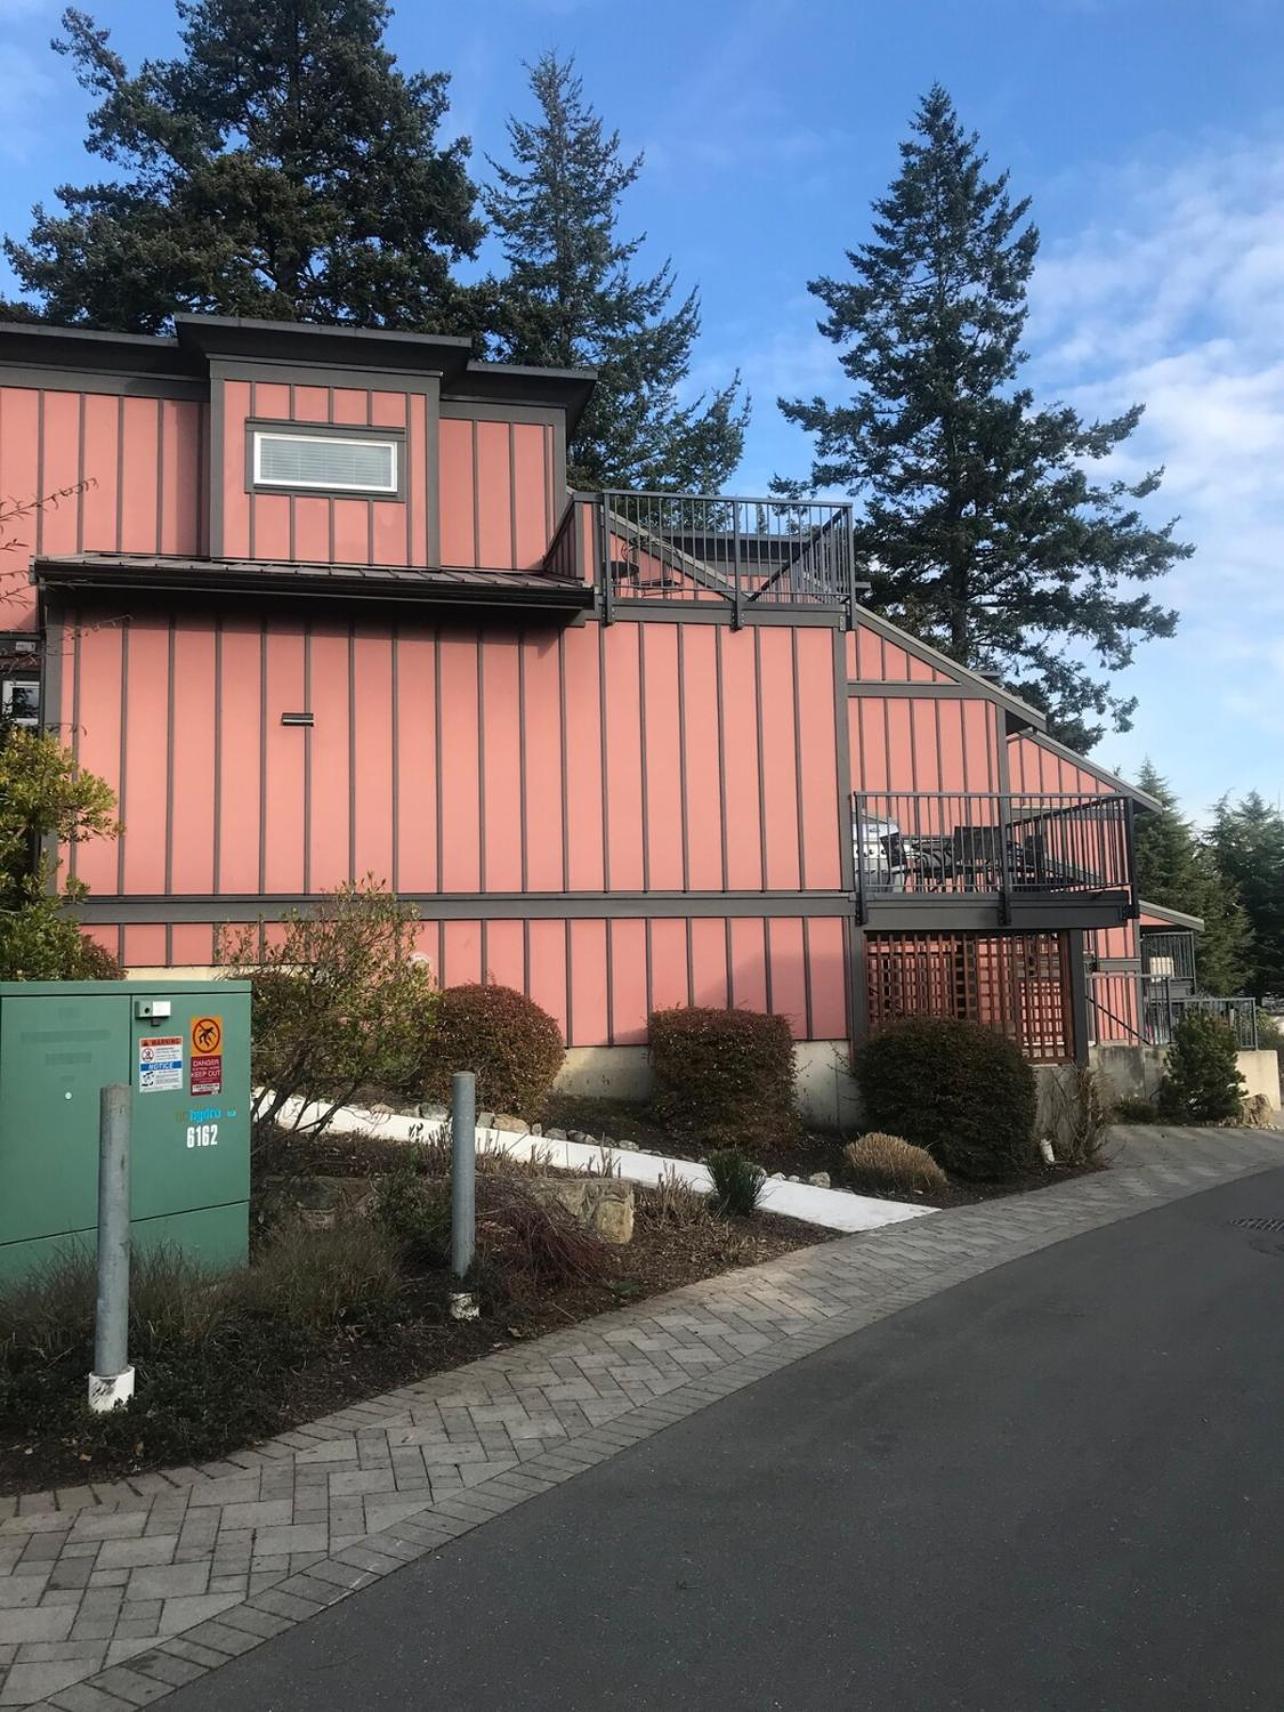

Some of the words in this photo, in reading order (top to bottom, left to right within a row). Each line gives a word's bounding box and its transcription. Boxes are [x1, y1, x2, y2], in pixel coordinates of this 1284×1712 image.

[148, 1062, 174, 1071] NOTICE
[193, 1059, 220, 1067] DANGER
[186, 1124, 218, 1148] 6162
